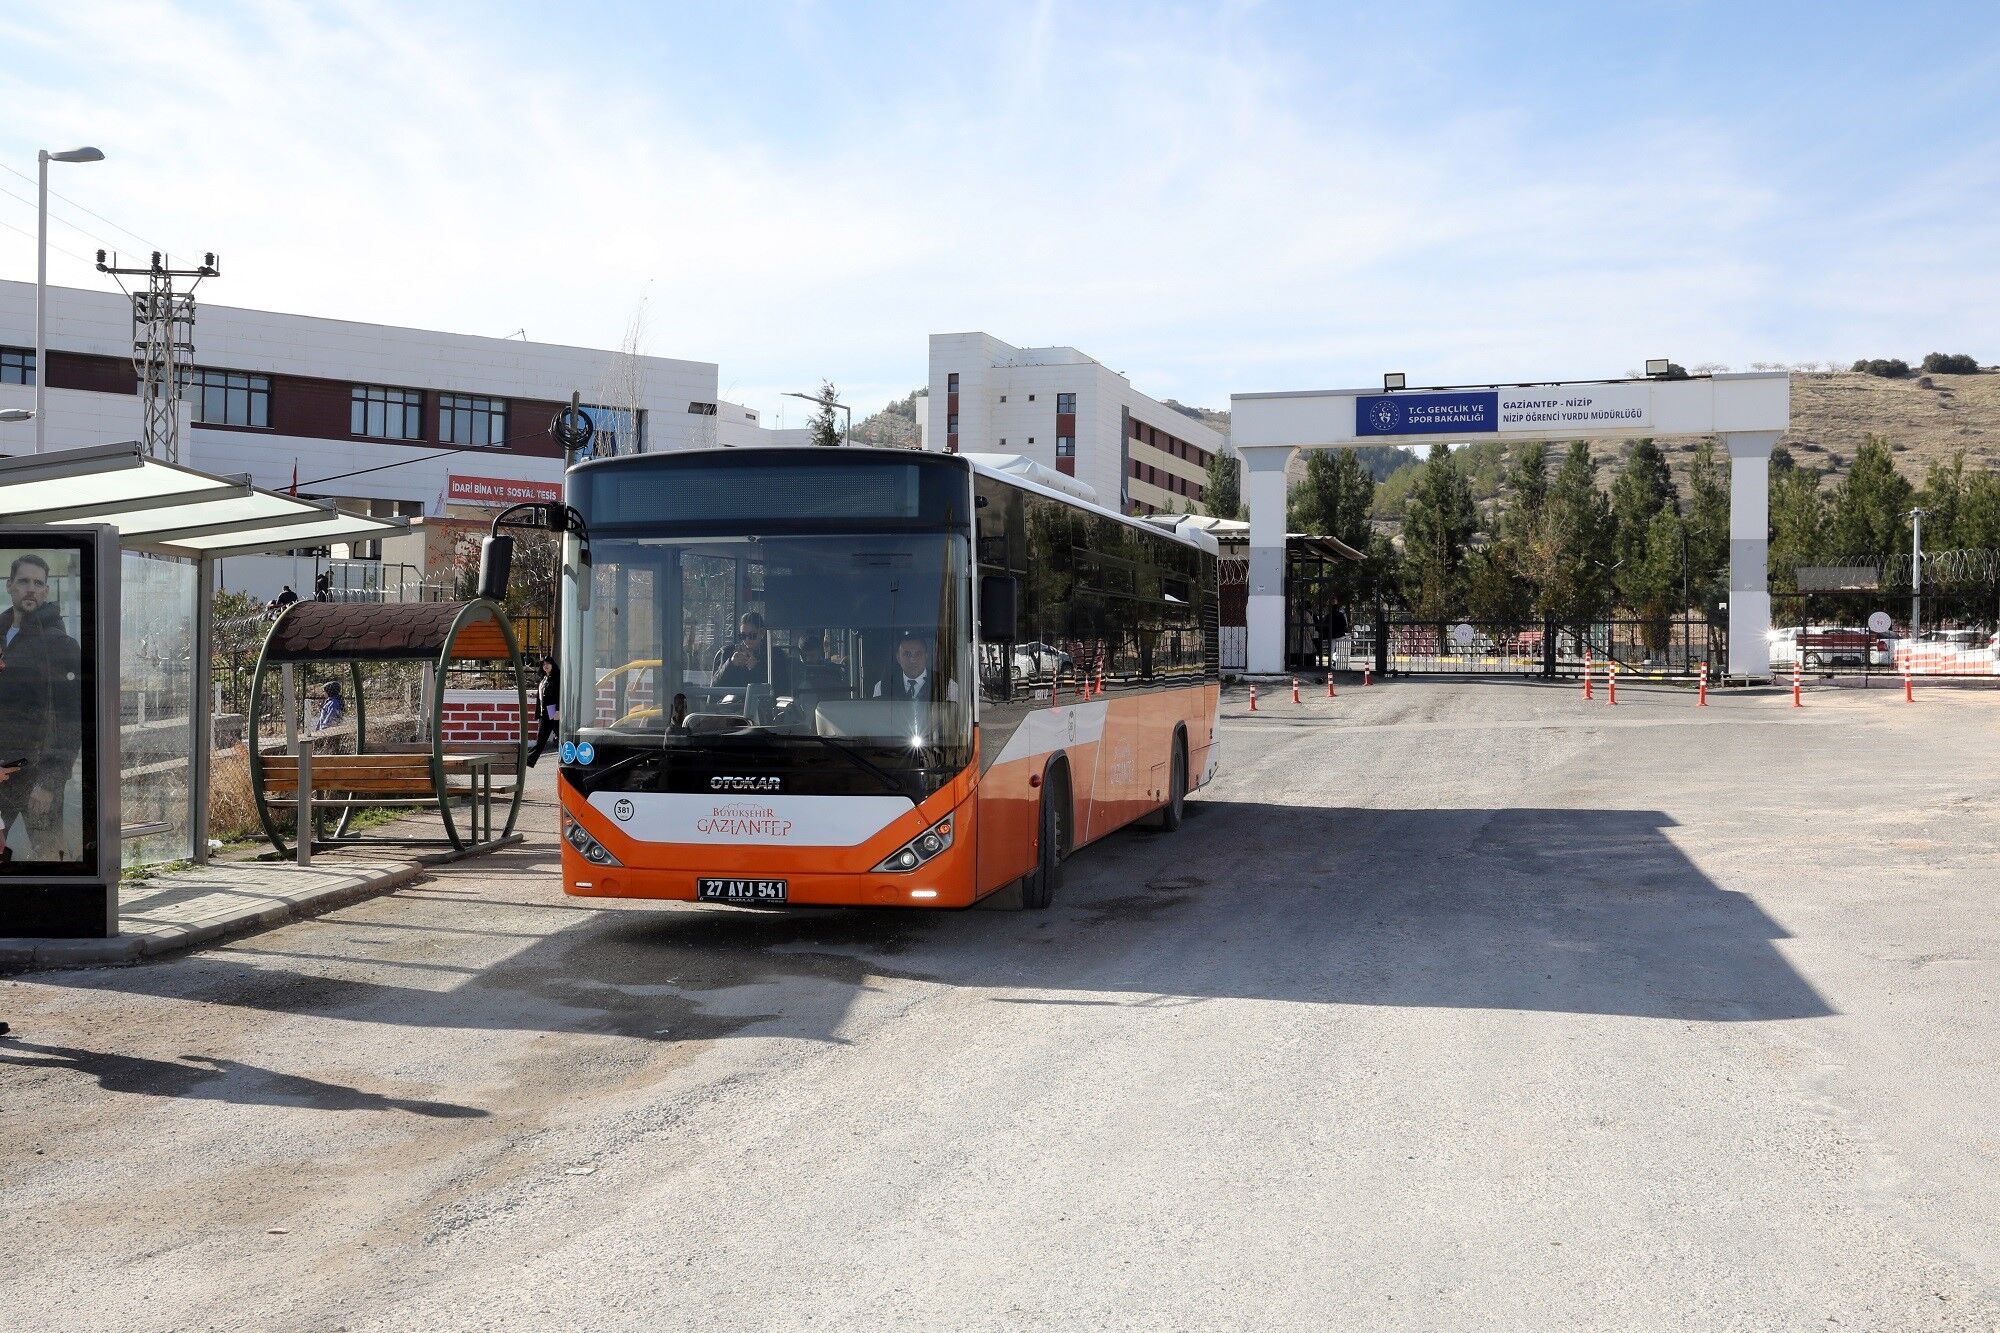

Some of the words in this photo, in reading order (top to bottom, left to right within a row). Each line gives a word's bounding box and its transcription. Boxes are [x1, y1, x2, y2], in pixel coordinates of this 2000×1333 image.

[1427, 404, 1469, 414] GENÇLİK
[1471, 404, 1484, 412] VE
[1503, 400, 1558, 409] GAZİANTEP
[1566, 398, 1593, 407] NİZİP
[1408, 416, 1433, 424] SPOR
[1434, 413, 1484, 423] BAKANLIĞI
[1503, 412, 1523, 422] NİZİP
[1525, 411, 1560, 422] ÖĞRENCİ
[1562, 412, 1589, 420] YURDU
[1591, 409, 1642, 420] MÜDÜRLÜĞÜ
[452, 481, 473, 493] İDARİ
[474, 483, 492, 494] BİNA
[494, 486, 504, 496] VE
[507, 486, 536, 498] SOSYAL
[710, 776, 781, 790] OTOKAR
[617, 806, 630, 814] 381
[706, 881, 723, 896] 27
[728, 882, 753, 897] AYJ
[758, 882, 783, 898] 541
